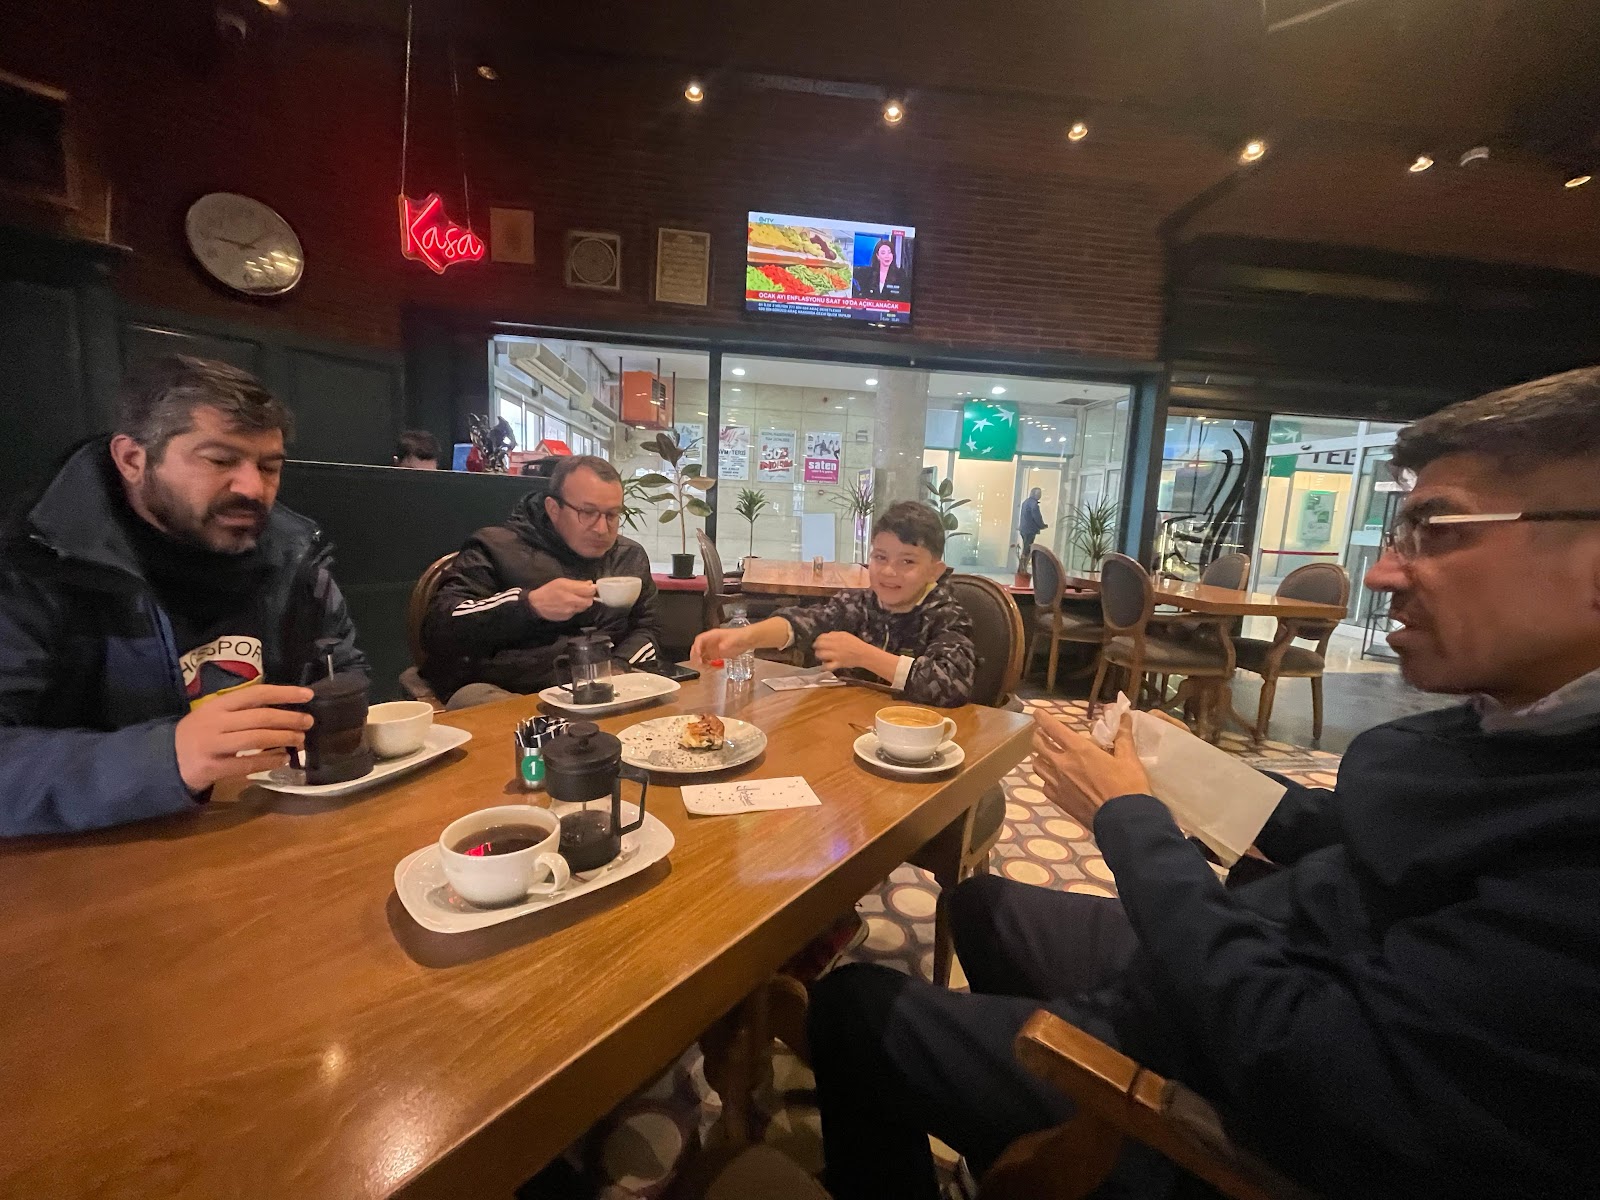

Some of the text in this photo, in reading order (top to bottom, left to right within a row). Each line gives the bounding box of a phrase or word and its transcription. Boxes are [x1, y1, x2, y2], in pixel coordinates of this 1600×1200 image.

[404, 197, 482, 268] Kasa
[786, 295, 826, 304] ENFLASYONU
[825, 297, 841, 305] SAAT
[858, 300, 899, 309] AÇIKLANACAK
[808, 460, 837, 471] saten
[529, 761, 537, 776] 1
